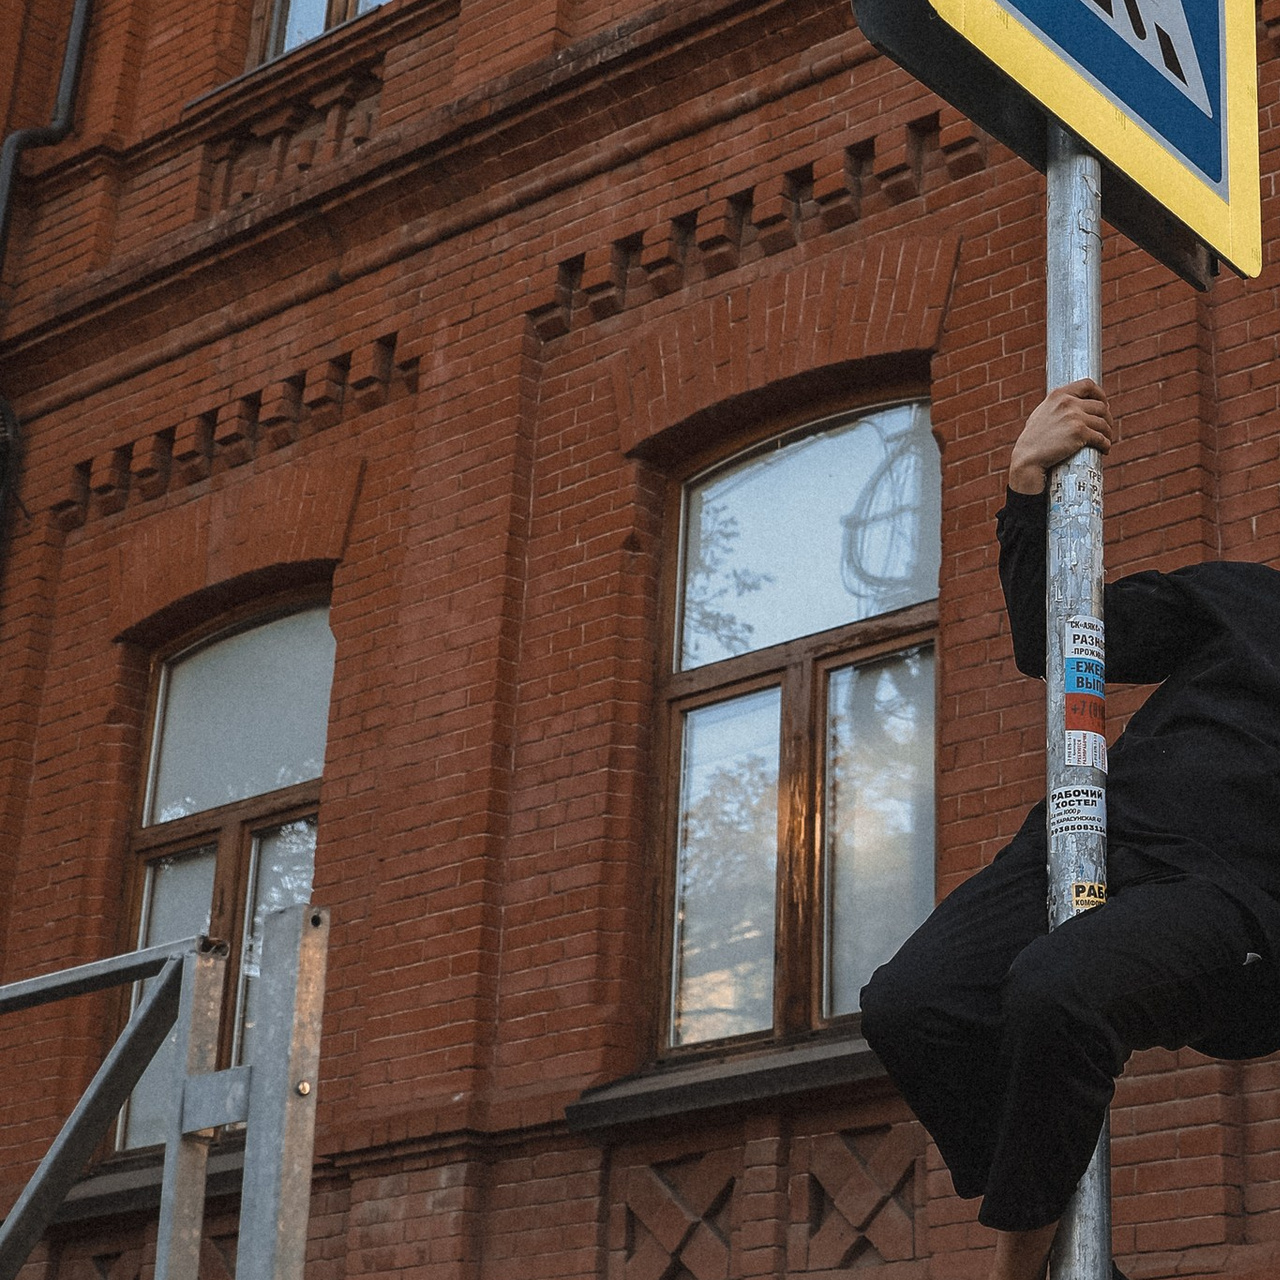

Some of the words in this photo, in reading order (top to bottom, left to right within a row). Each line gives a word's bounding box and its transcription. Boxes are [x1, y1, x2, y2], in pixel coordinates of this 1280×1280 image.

[1073, 634, 1104, 651] РАЗН
[1051, 790, 1103, 802] РАБОЧИЙ
[1055, 799, 1097, 810] ХОСТЕЛ
